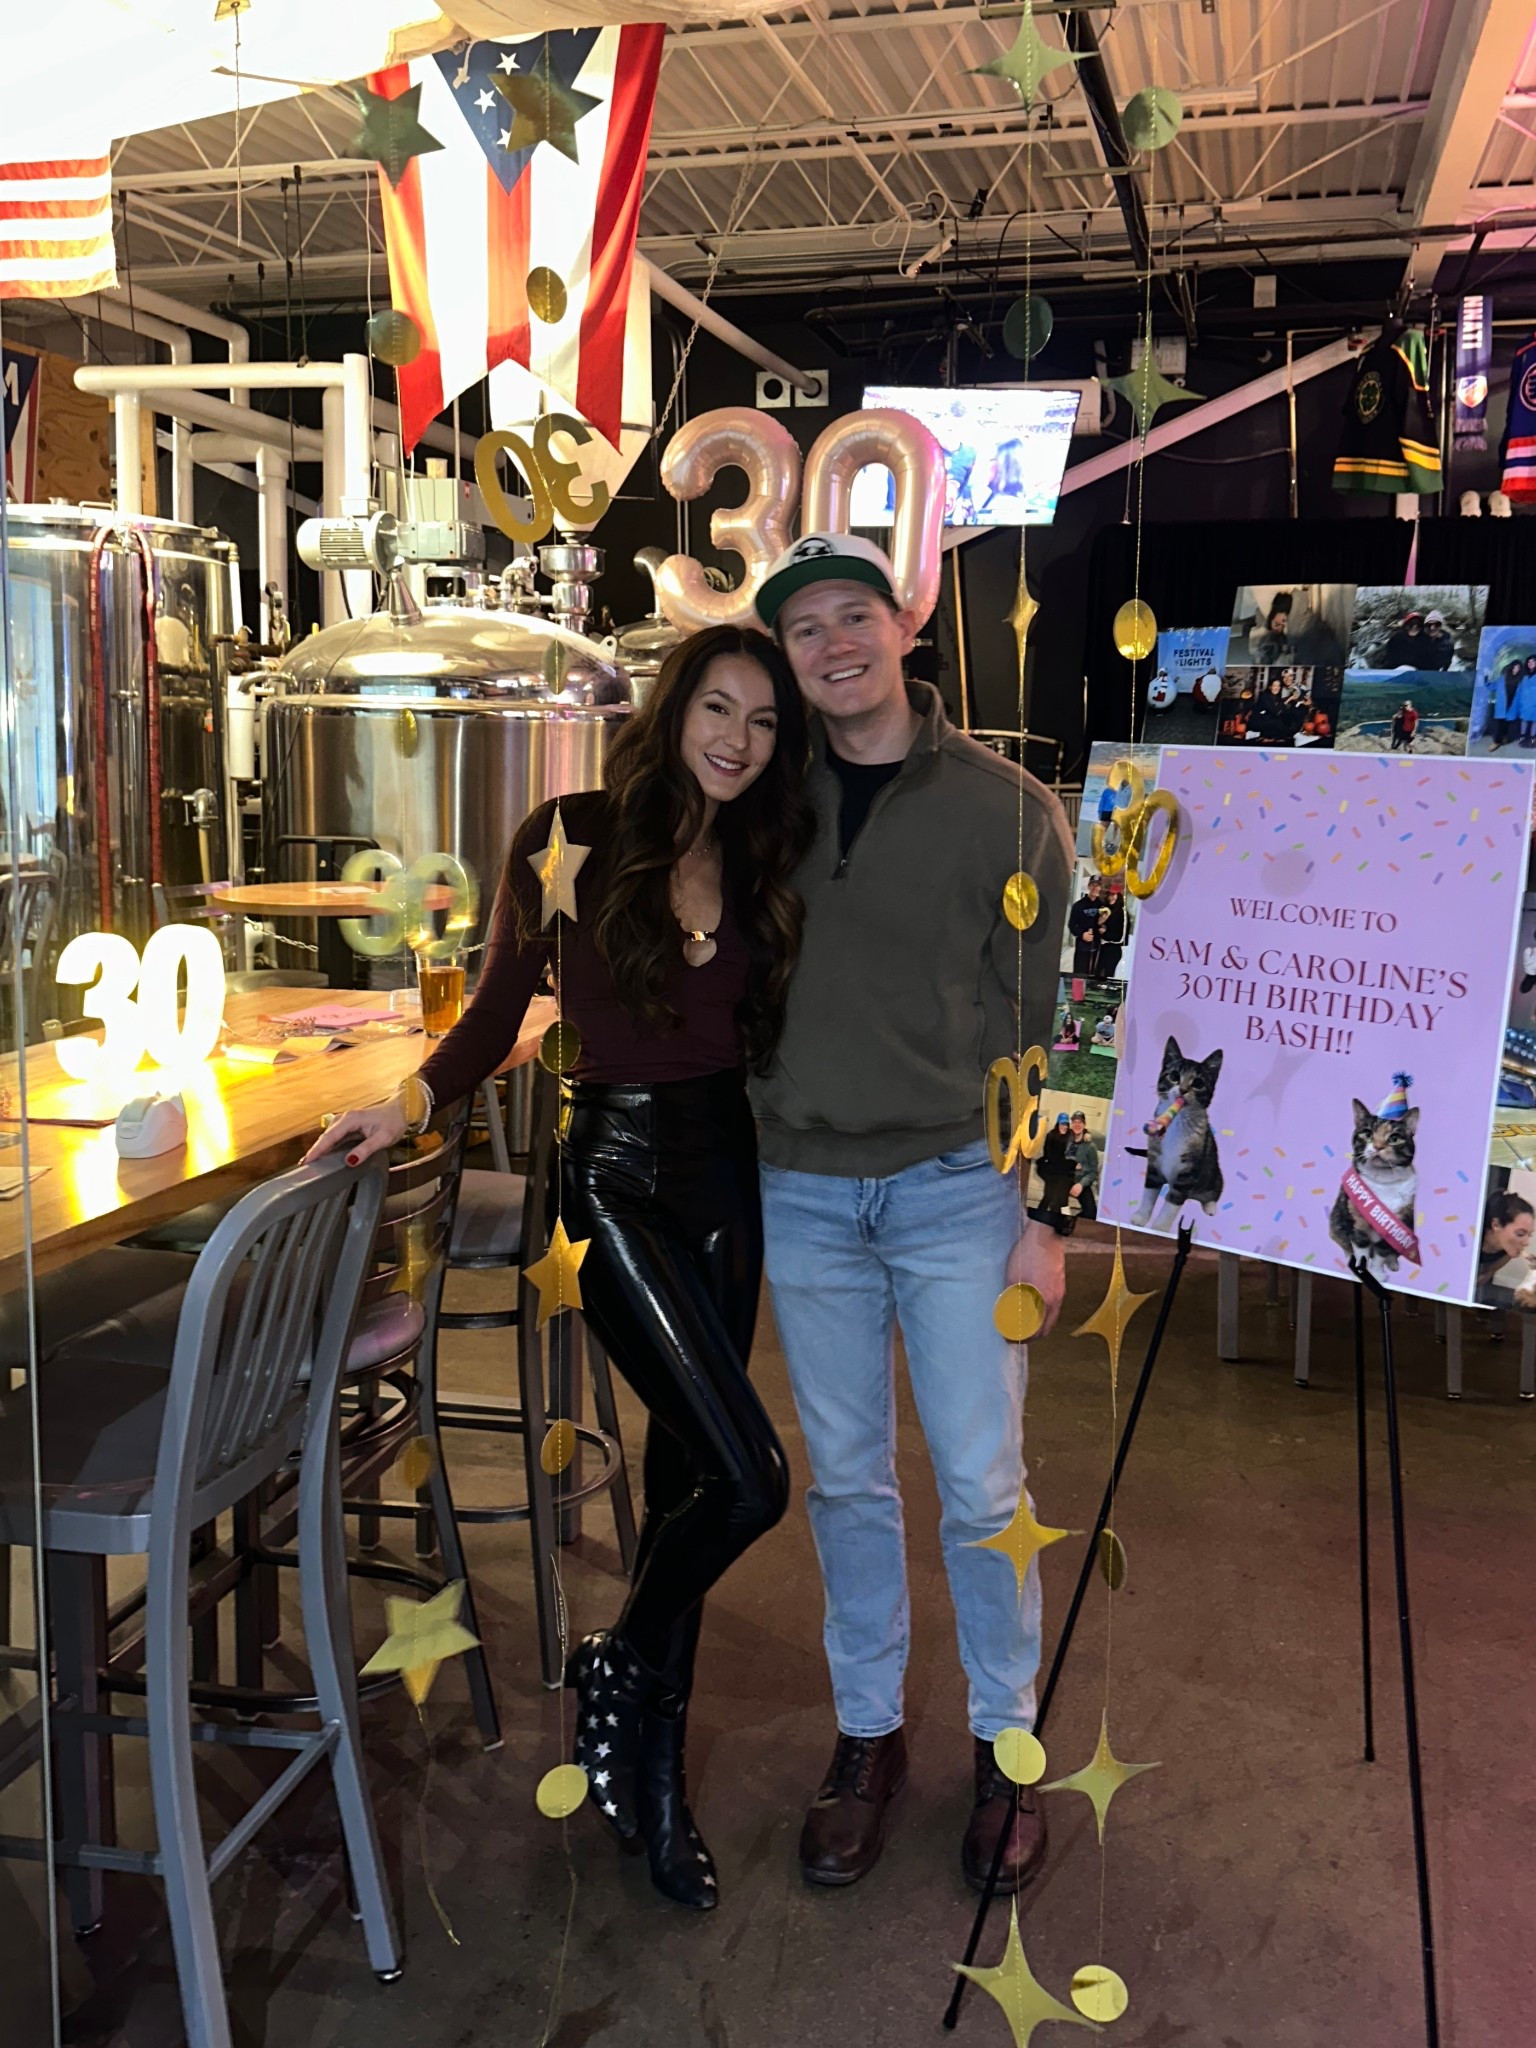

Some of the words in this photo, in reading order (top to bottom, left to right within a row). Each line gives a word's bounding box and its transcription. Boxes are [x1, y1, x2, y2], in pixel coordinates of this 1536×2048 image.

[655, 406, 946, 637] 30
[1173, 648, 1215, 657] FESTIVAL
[1180, 658, 1212, 666] LIGHTS
[1230, 897, 1356, 930] WELCOME
[1361, 911, 1397, 933] TO
[1149, 936, 1213, 966] SAM
[1221, 945, 1248, 971] &
[1258, 949, 1468, 999] CAROLINE'S
[55, 923, 226, 1083] 30
[1176, 972, 1257, 1006] 30TH
[1266, 984, 1444, 1032] BIRTHDAY
[1245, 1015, 1354, 1055] BASH!!
[1346, 1174, 1375, 1207] HAPPY
[1370, 1205, 1413, 1249] BIRTHDAY
